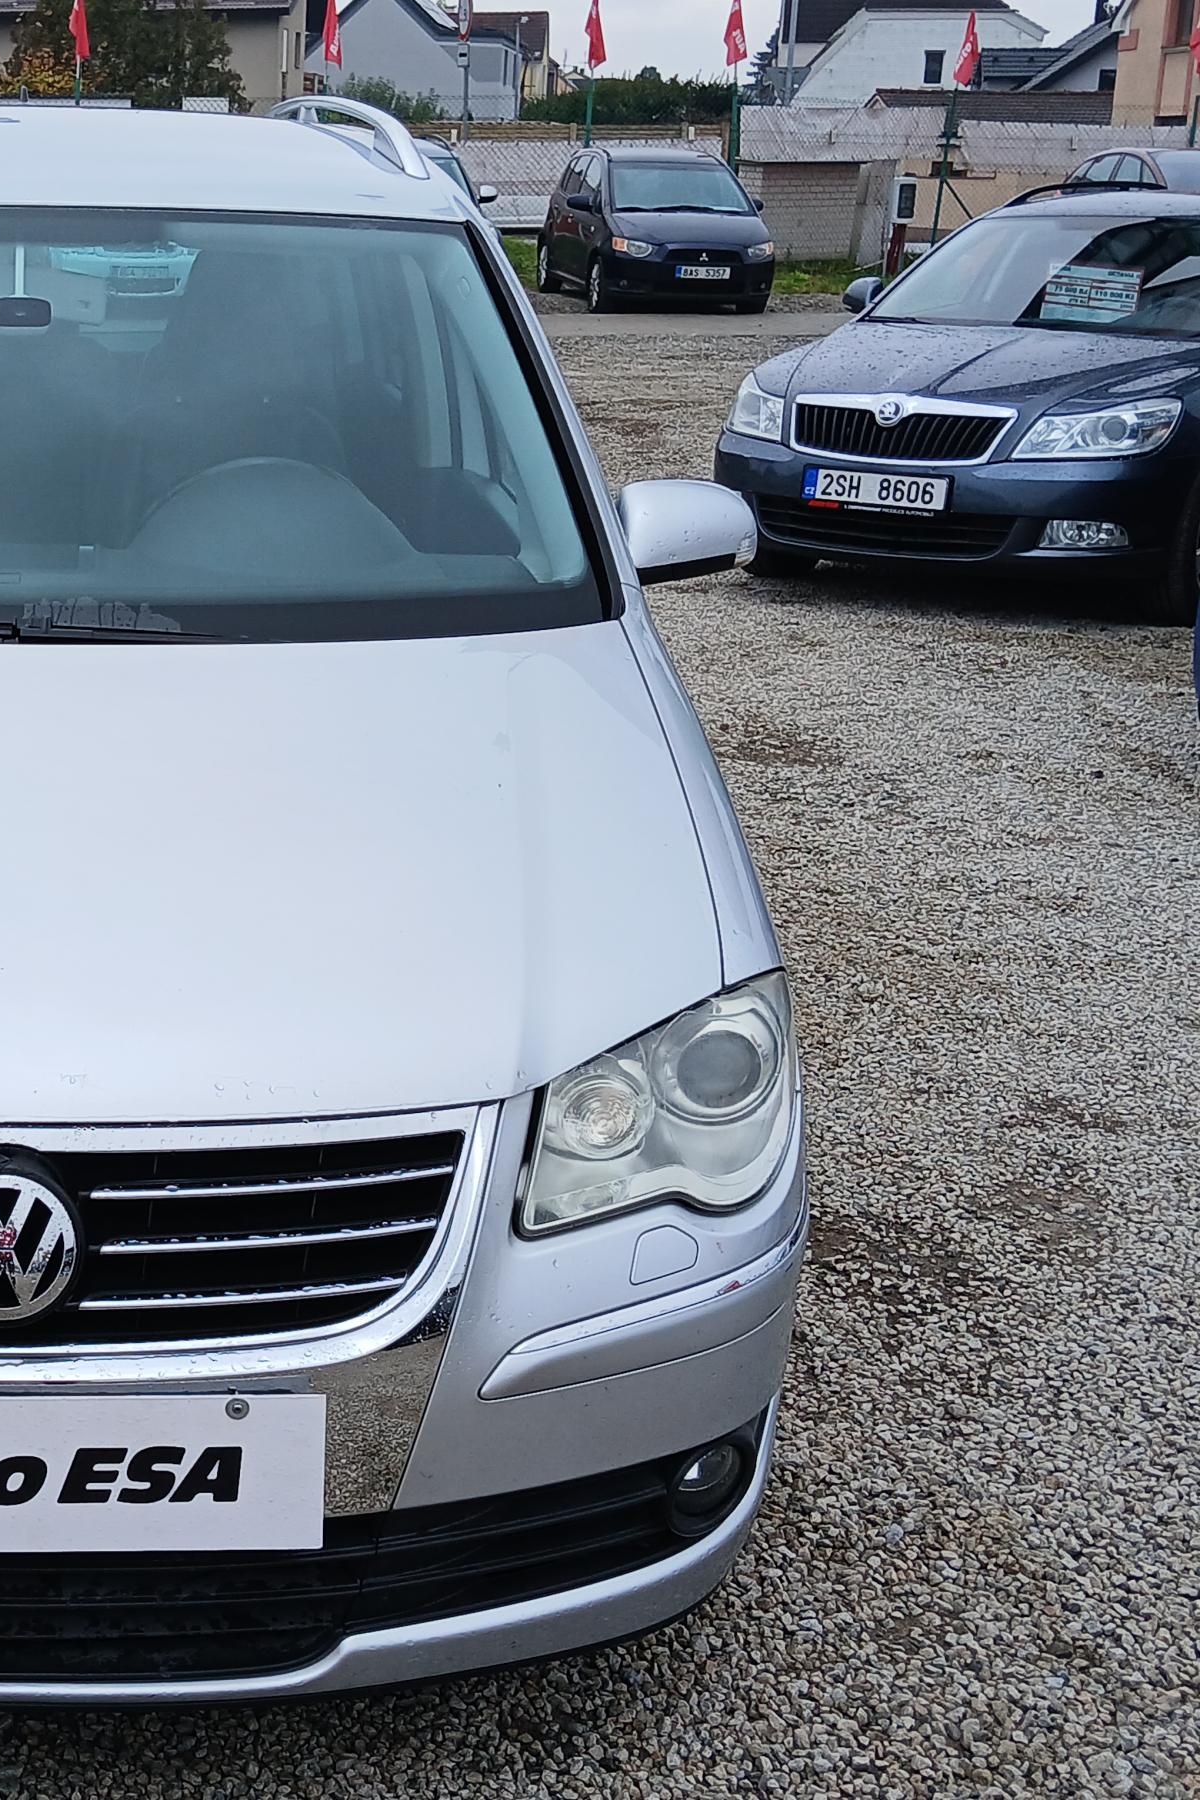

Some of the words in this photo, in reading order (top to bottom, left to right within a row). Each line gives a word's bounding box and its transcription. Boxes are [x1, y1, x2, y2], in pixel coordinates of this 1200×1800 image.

[820, 473, 862, 499] 2SH
[878, 478, 935, 505] 8606
[57, 1446, 243, 1504] ESA
